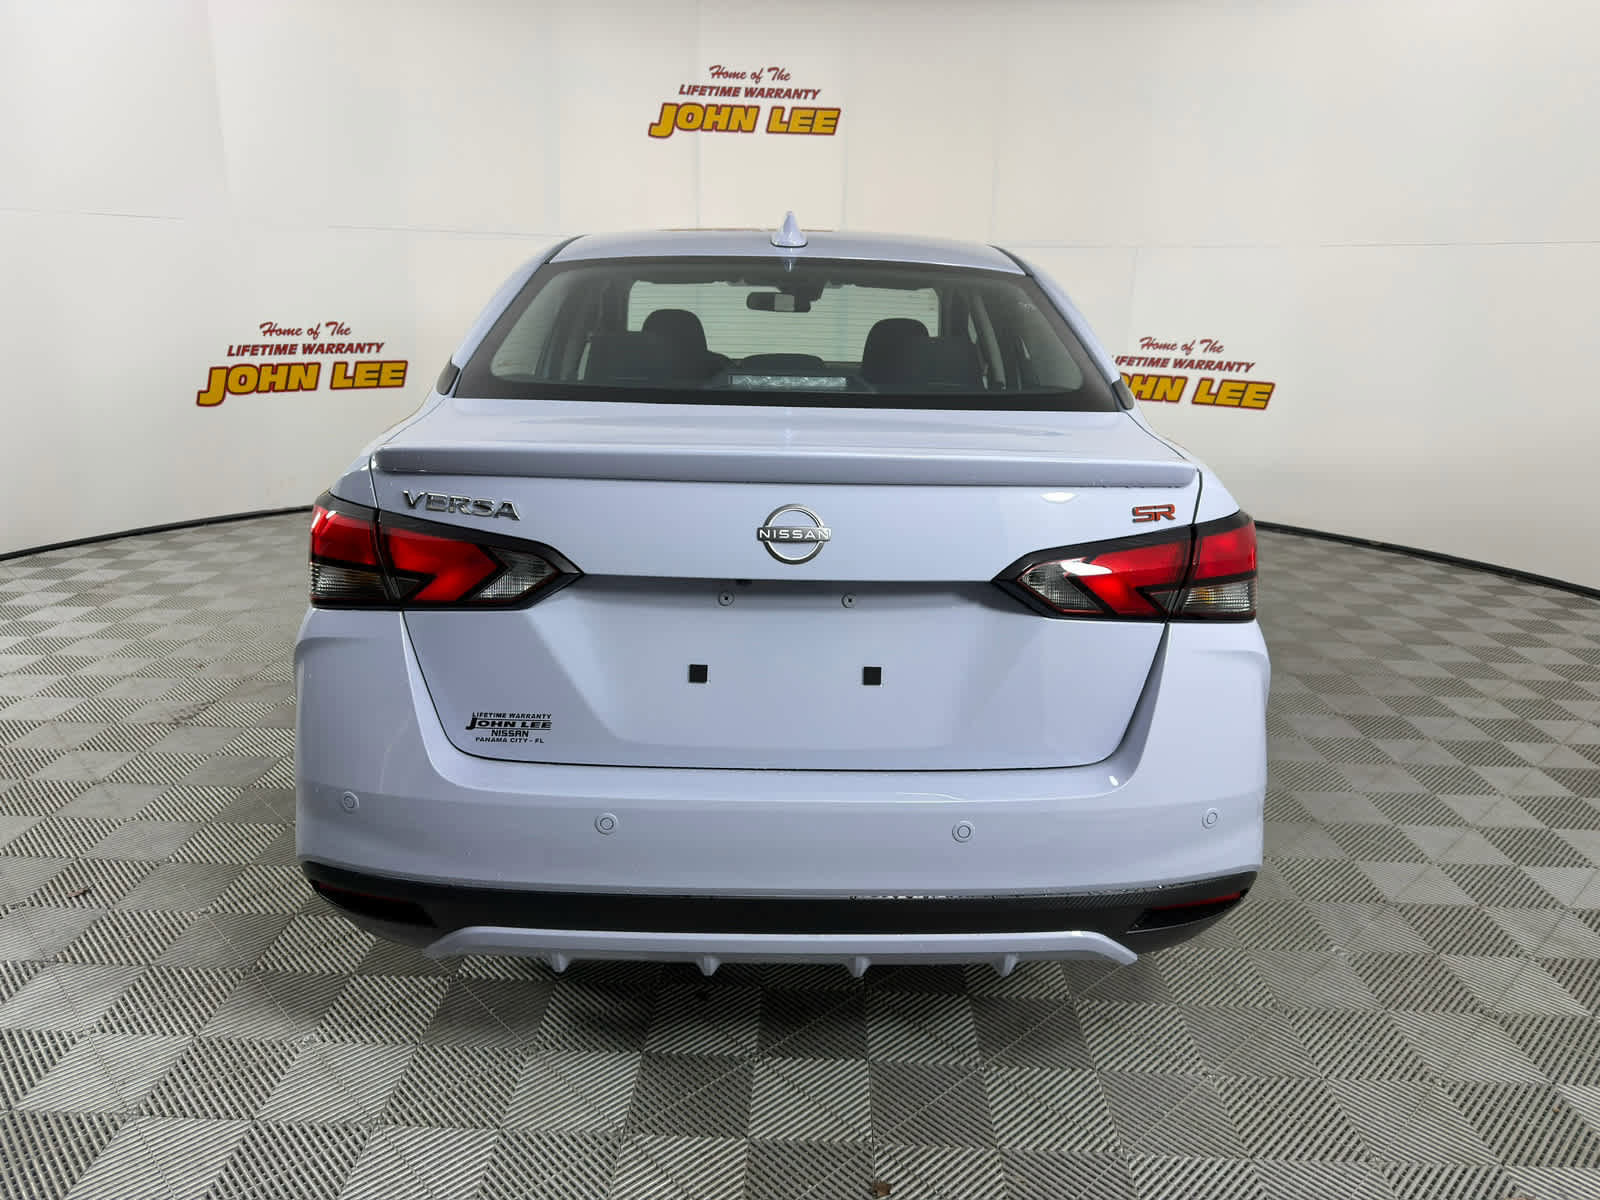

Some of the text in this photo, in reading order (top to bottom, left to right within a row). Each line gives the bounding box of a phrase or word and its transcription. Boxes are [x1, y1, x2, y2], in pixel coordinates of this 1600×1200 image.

[709, 65, 791, 84] Home of The
[679, 84, 821, 100] LIFETIME WARRANTY
[648, 102, 841, 138] JOHN LEE
[259, 321, 351, 340] Home of The
[227, 342, 384, 357] LIFETIME WARRANTY
[1139, 336, 1225, 356] Home of The
[1172, 358, 1256, 373] WARRANTY
[196, 360, 408, 407] JOHN LEE
[1191, 377, 1276, 410] LEE
[403, 490, 521, 521] VERSA
[1132, 503, 1176, 523] SR
[759, 529, 830, 540] NISSAN
[465, 717, 552, 730] JOHN LEE
[491, 729, 529, 737] NISSAN
